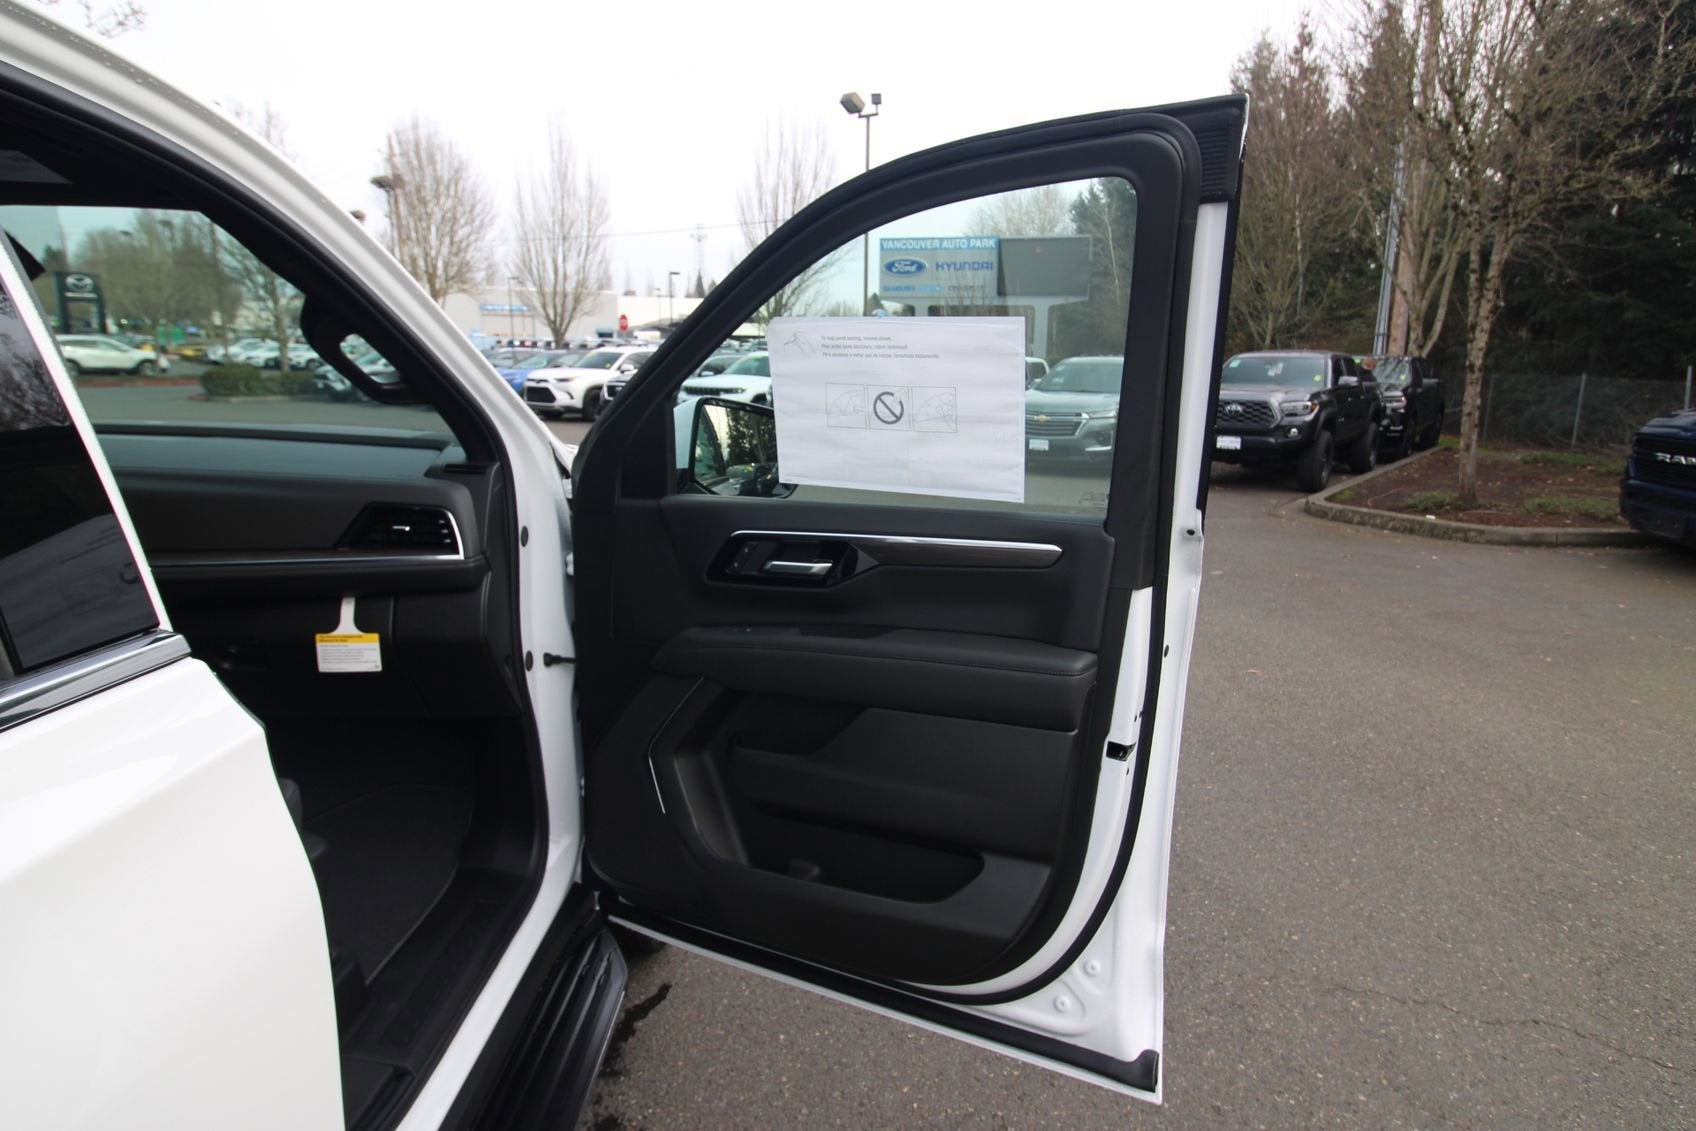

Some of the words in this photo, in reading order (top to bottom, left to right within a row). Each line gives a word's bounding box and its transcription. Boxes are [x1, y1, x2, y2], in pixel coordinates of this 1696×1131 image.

[881, 239, 940, 249] VANCOUVER
[942, 238, 968, 249] AUTO
[970, 238, 996, 248] PARK
[936, 261, 993, 271] HYUNDAI
